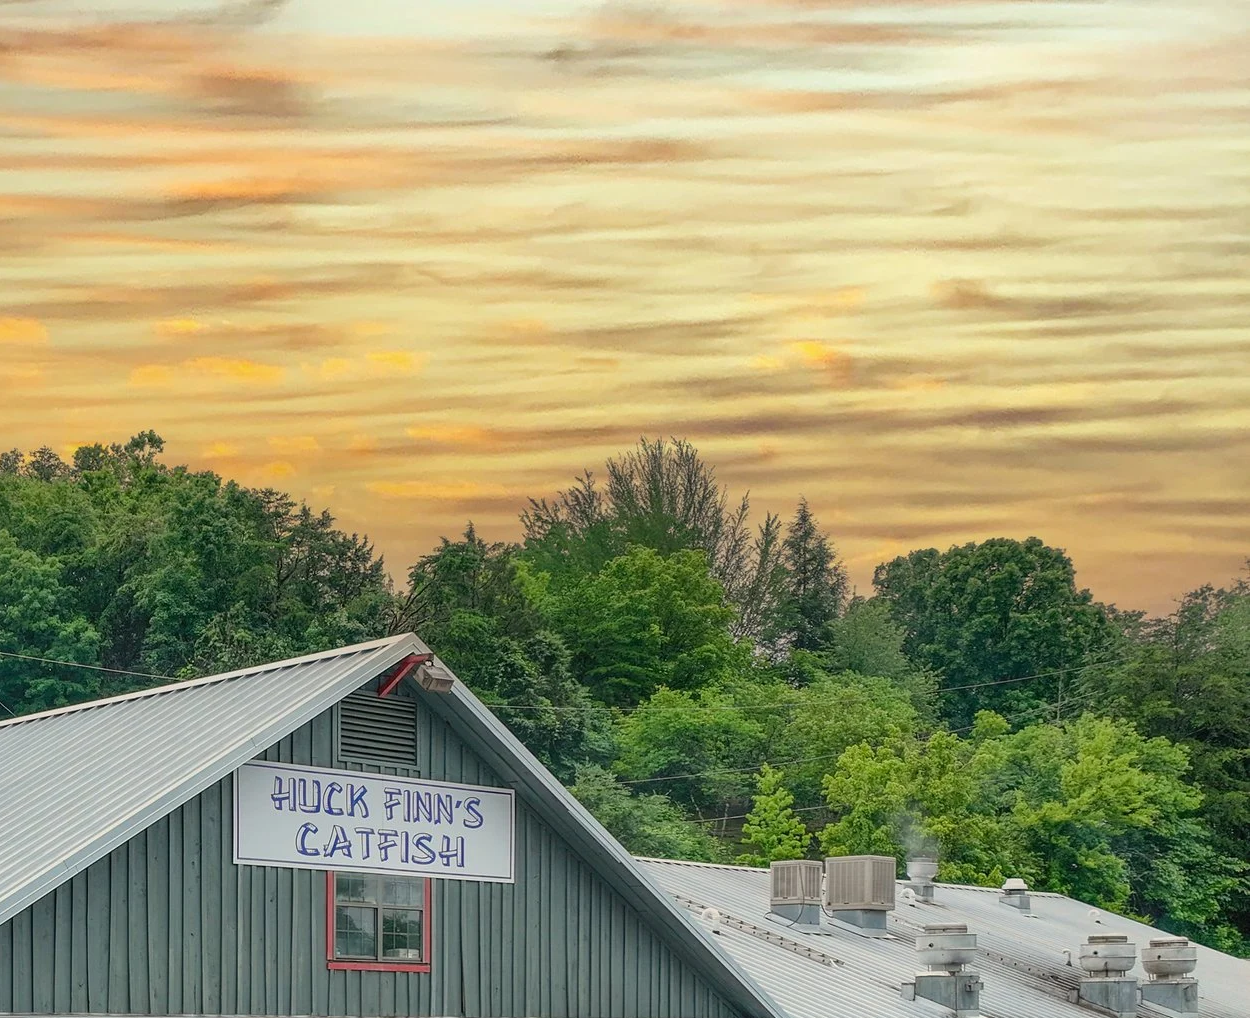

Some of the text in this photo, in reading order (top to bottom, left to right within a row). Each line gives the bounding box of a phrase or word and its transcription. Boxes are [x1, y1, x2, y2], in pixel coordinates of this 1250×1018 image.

[271, 776, 484, 829] HUCK FINN'S
[295, 822, 465, 868] CATFISH
